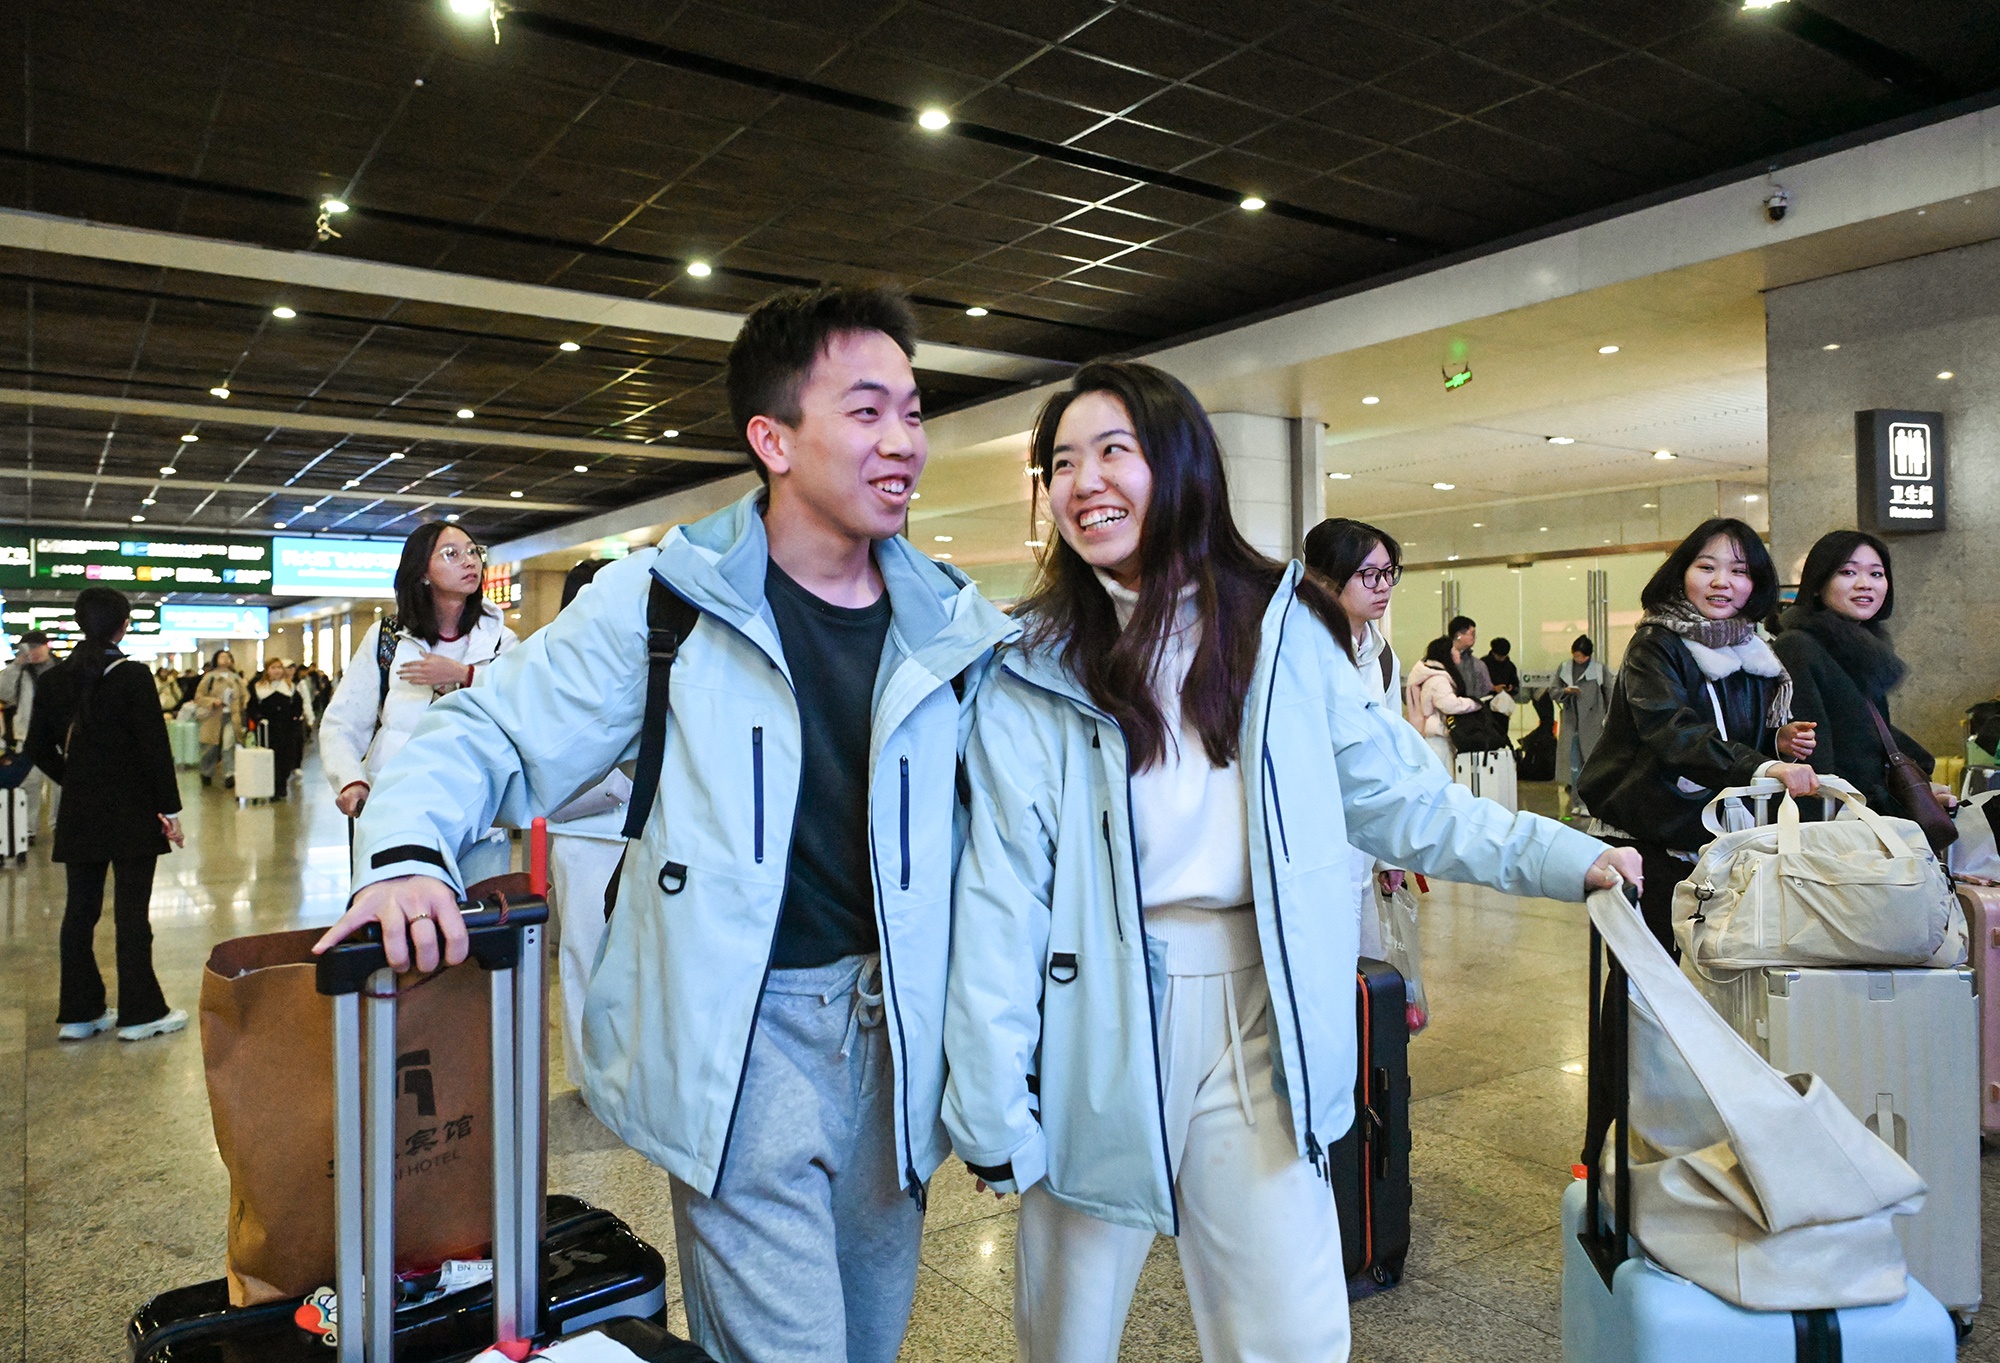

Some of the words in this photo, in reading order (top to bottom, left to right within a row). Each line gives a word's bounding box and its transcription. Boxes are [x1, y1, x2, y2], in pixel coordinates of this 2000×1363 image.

[1889, 484, 1934, 505] 卫生间
[408, 1149, 461, 1177] HOTEL
[457, 1263, 471, 1272] BN
